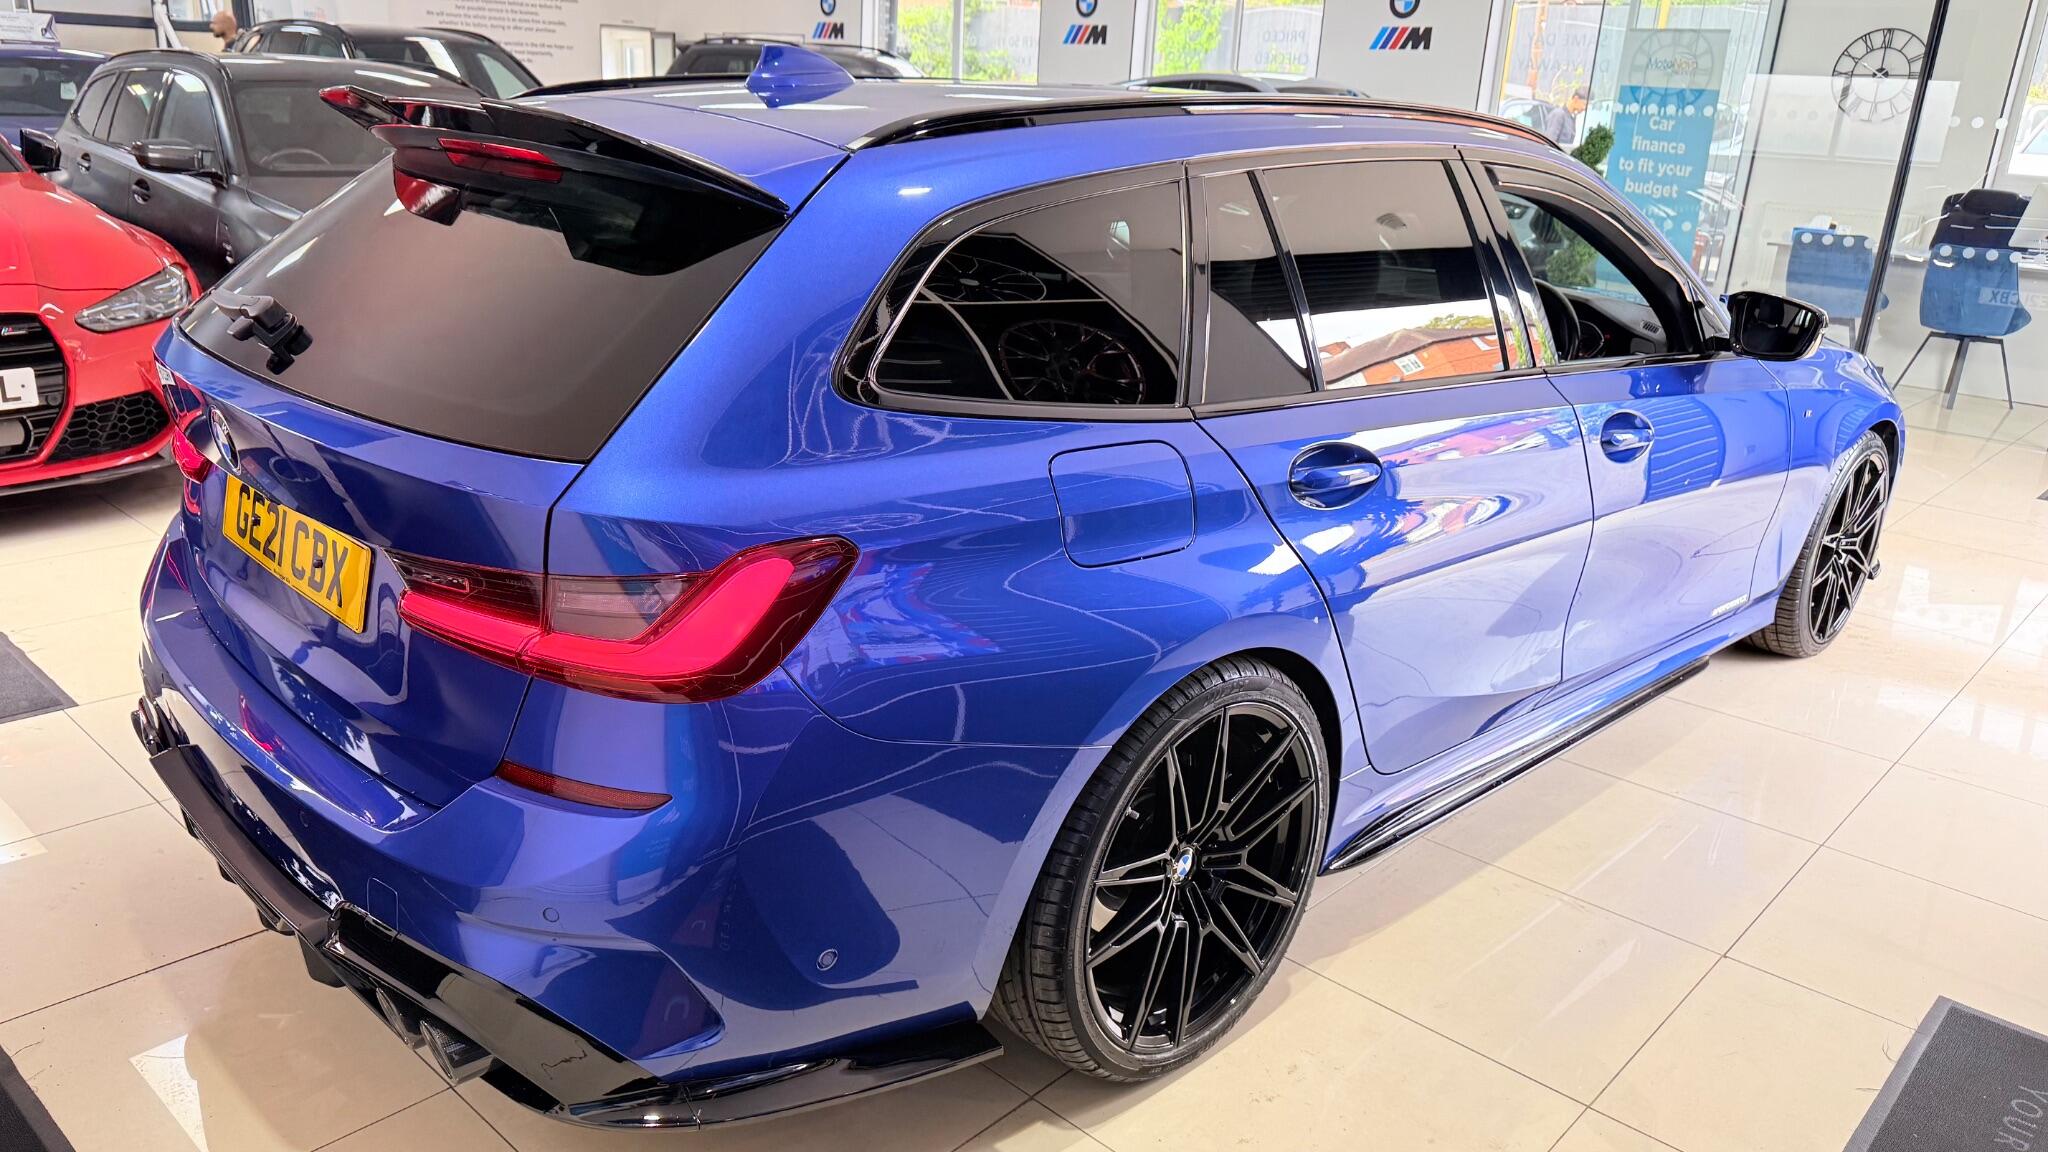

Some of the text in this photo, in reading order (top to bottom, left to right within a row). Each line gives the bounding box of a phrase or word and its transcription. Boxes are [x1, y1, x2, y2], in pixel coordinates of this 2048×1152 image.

[1649, 115, 1676, 131] Car
[1632, 136, 1686, 154] finance
[1618, 157, 1693, 178] to fit your
[1624, 178, 1679, 199] budget
[236, 483, 349, 609] GE21 CBX
